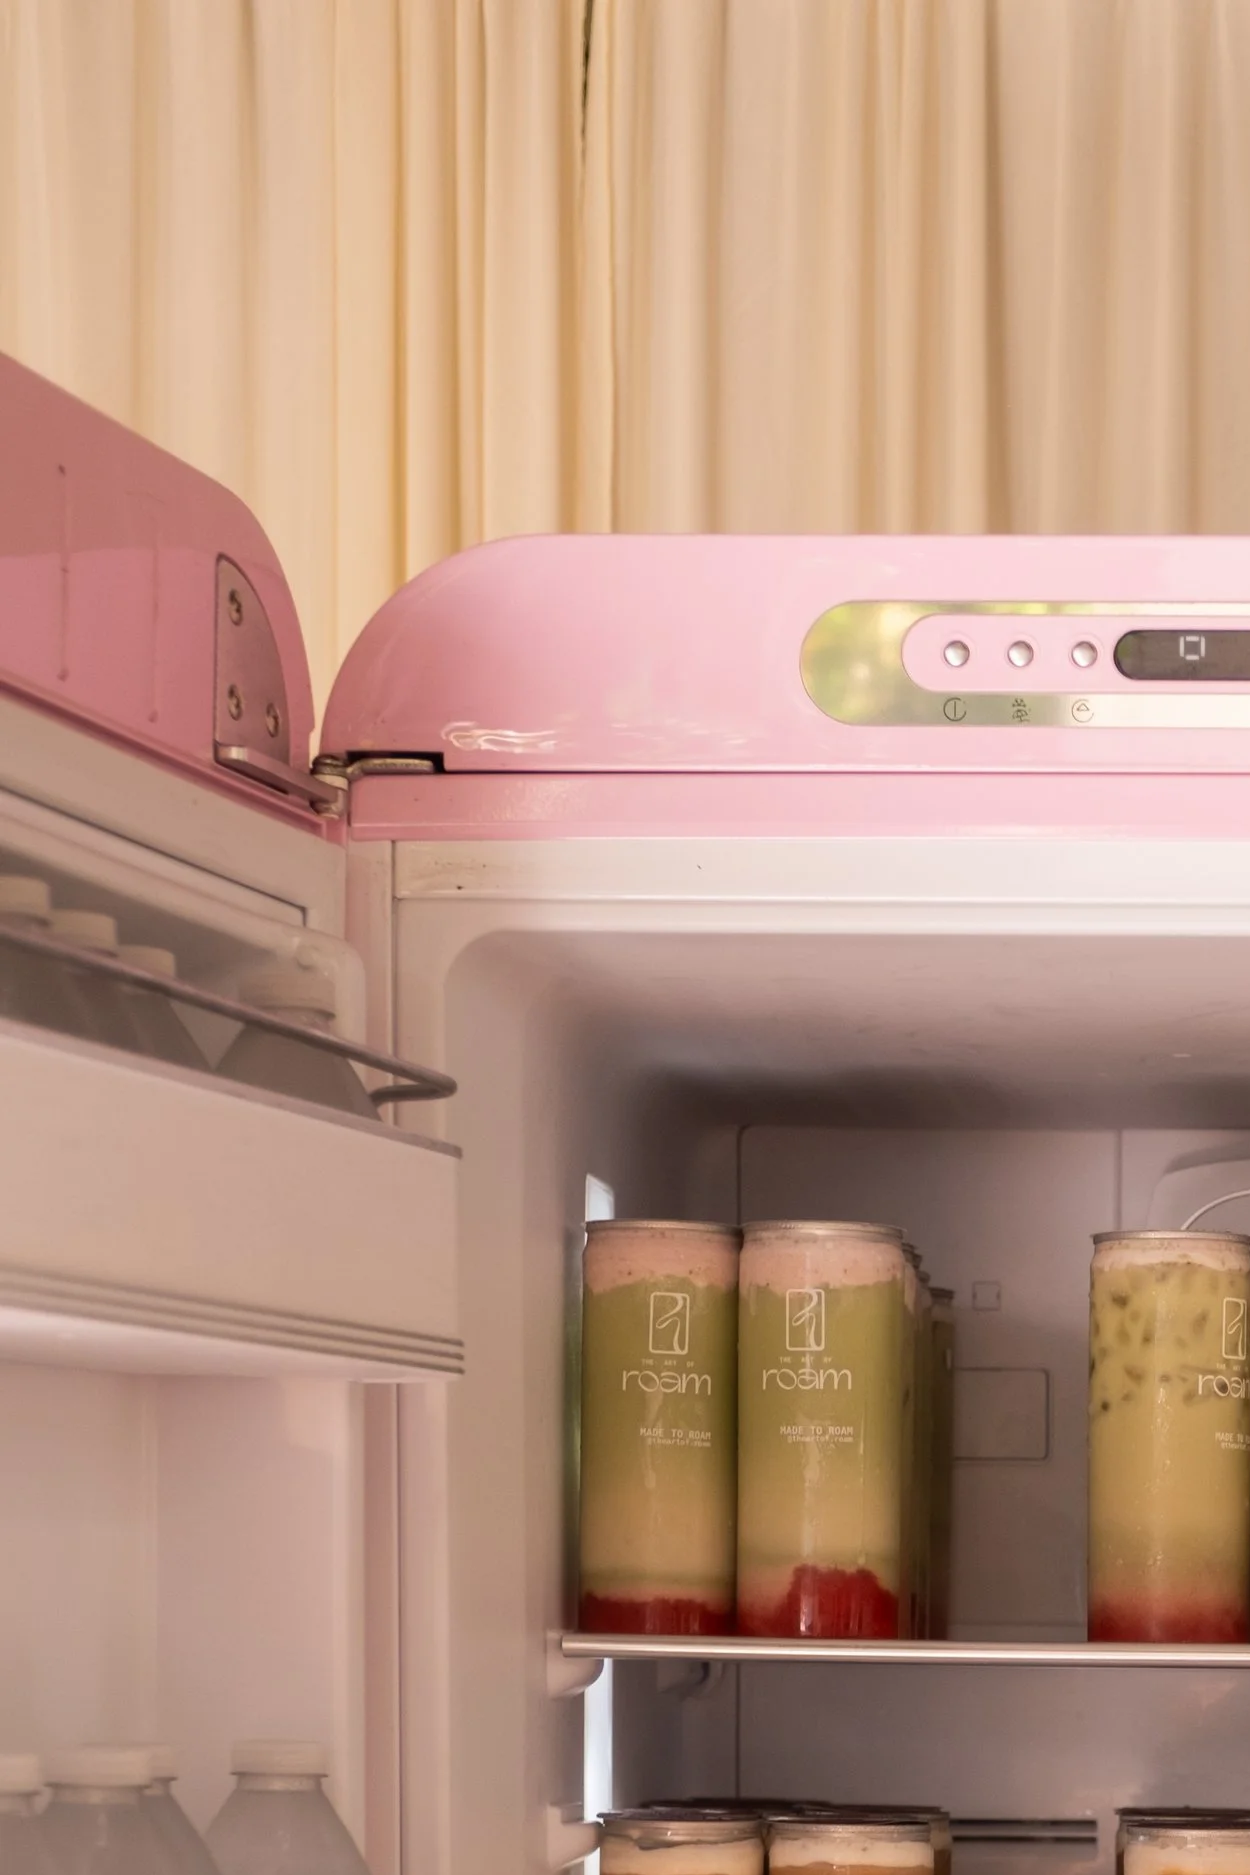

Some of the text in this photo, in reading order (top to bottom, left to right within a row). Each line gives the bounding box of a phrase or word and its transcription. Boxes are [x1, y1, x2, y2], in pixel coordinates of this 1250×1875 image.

[622, 1370, 712, 1396] roam
[762, 1368, 852, 1390] roam
[639, 1427, 712, 1440] MADE TO ROAM
[780, 1426, 854, 1436] MADE TO ROAM
